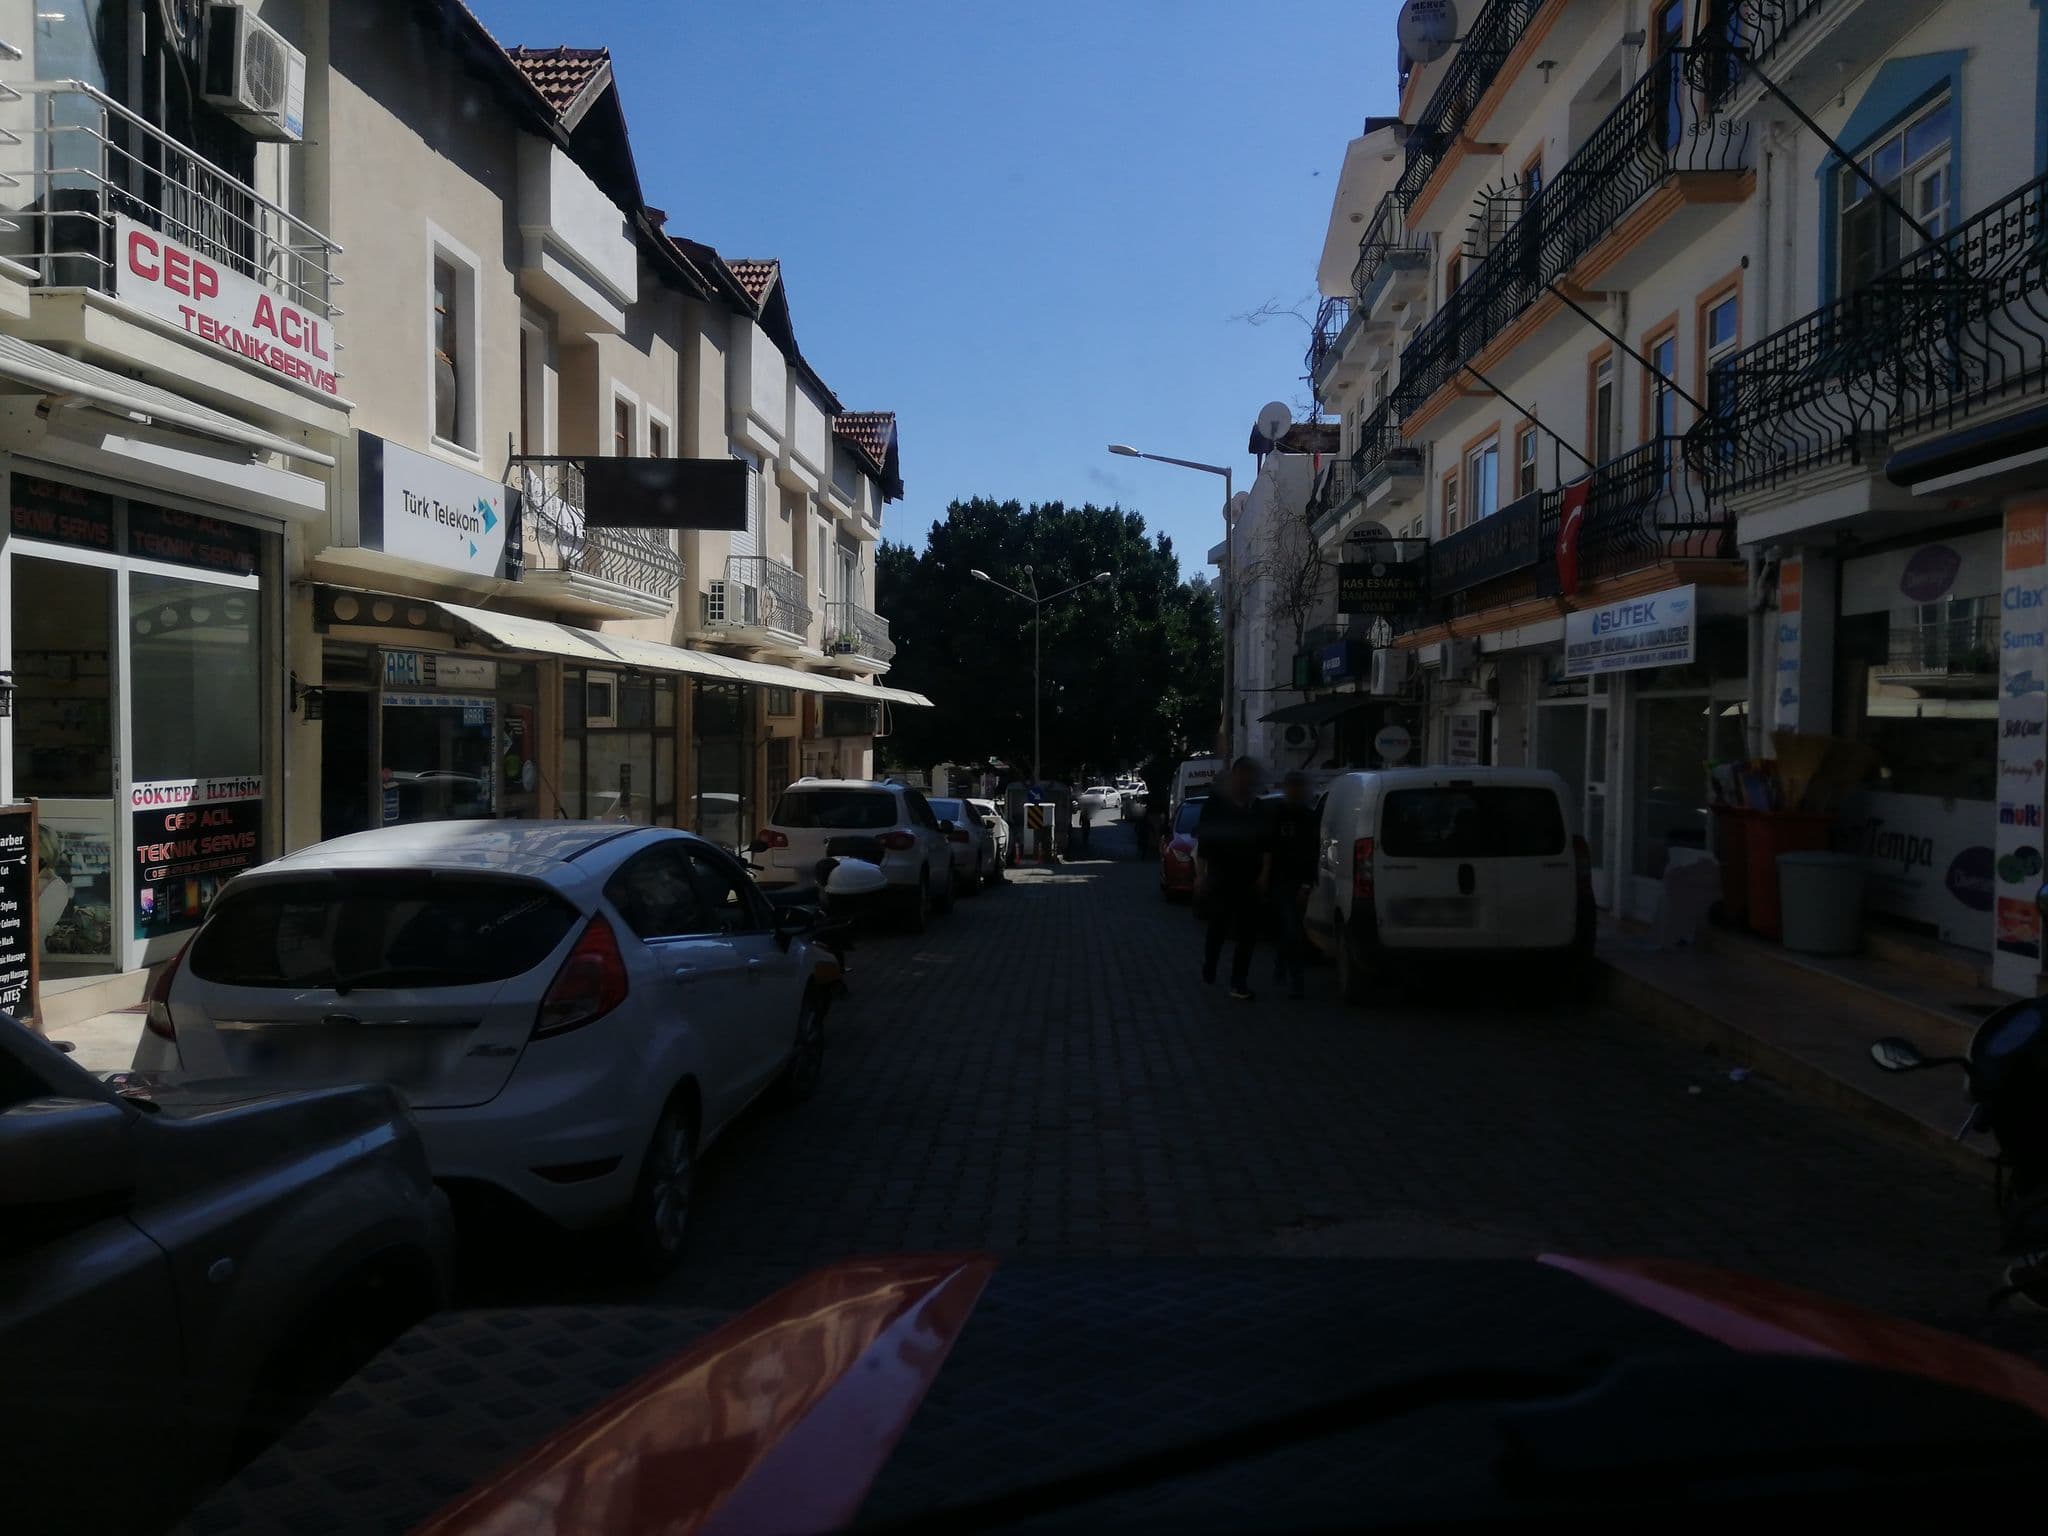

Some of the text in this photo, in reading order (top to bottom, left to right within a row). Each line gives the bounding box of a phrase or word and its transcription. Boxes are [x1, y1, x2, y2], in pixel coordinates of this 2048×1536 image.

[128, 230, 219, 301] CEP
[402, 488, 480, 534] Türk Telekom
[2004, 585, 2044, 610] Clax
[1600, 601, 1657, 631] SUTEK
[2003, 630, 2044, 649] Suma
[131, 784, 200, 805] GÖKTEPE
[164, 812, 198, 832] CEP
